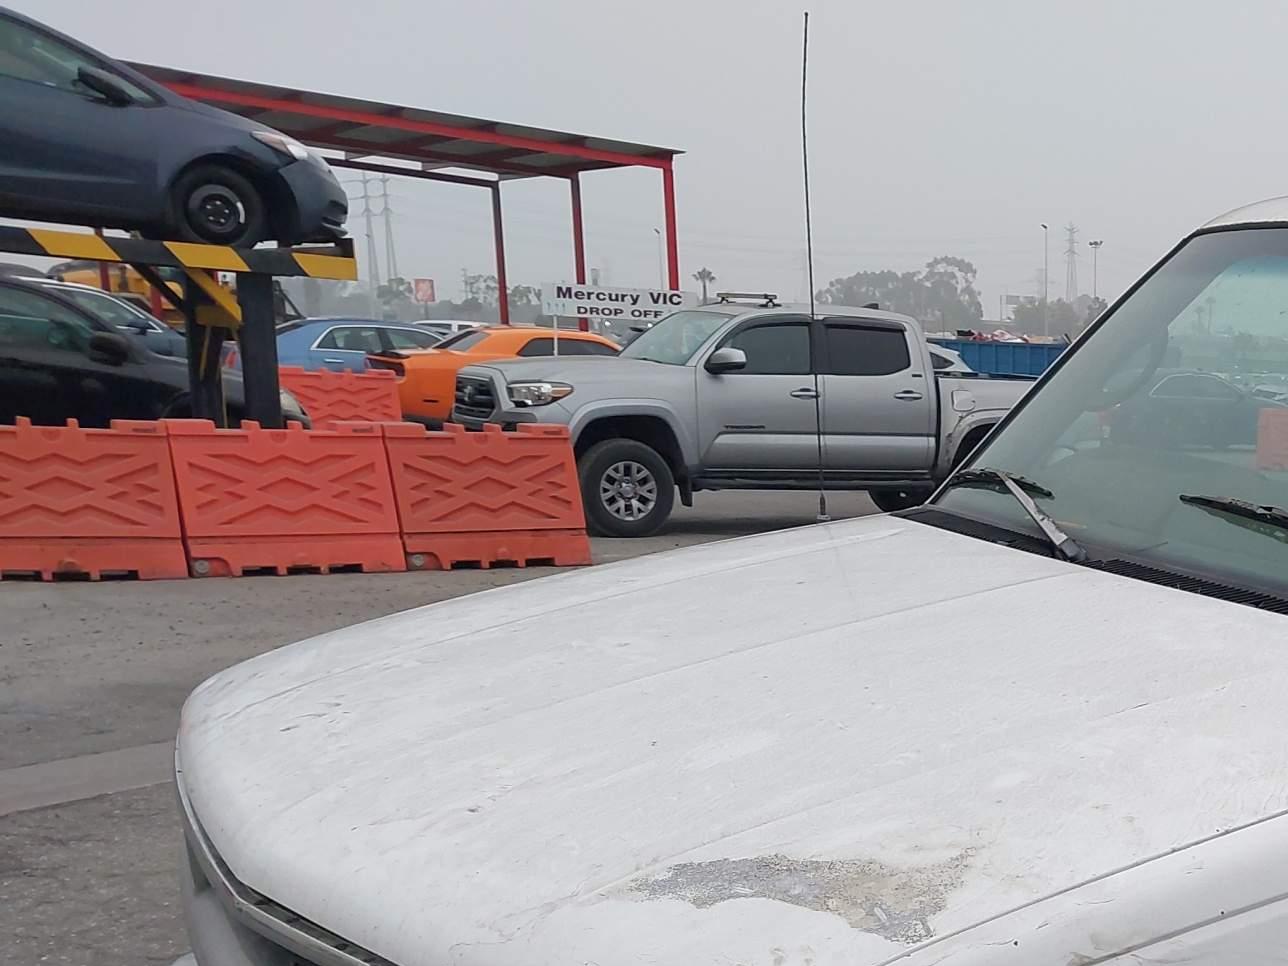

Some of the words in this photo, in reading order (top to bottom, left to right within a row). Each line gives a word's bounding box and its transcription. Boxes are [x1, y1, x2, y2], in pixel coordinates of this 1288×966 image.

[556, 286, 640, 305] Mercury
[649, 292, 682, 305] VIC
[577, 306, 624, 317] DROP
[631, 309, 664, 319] OFF
